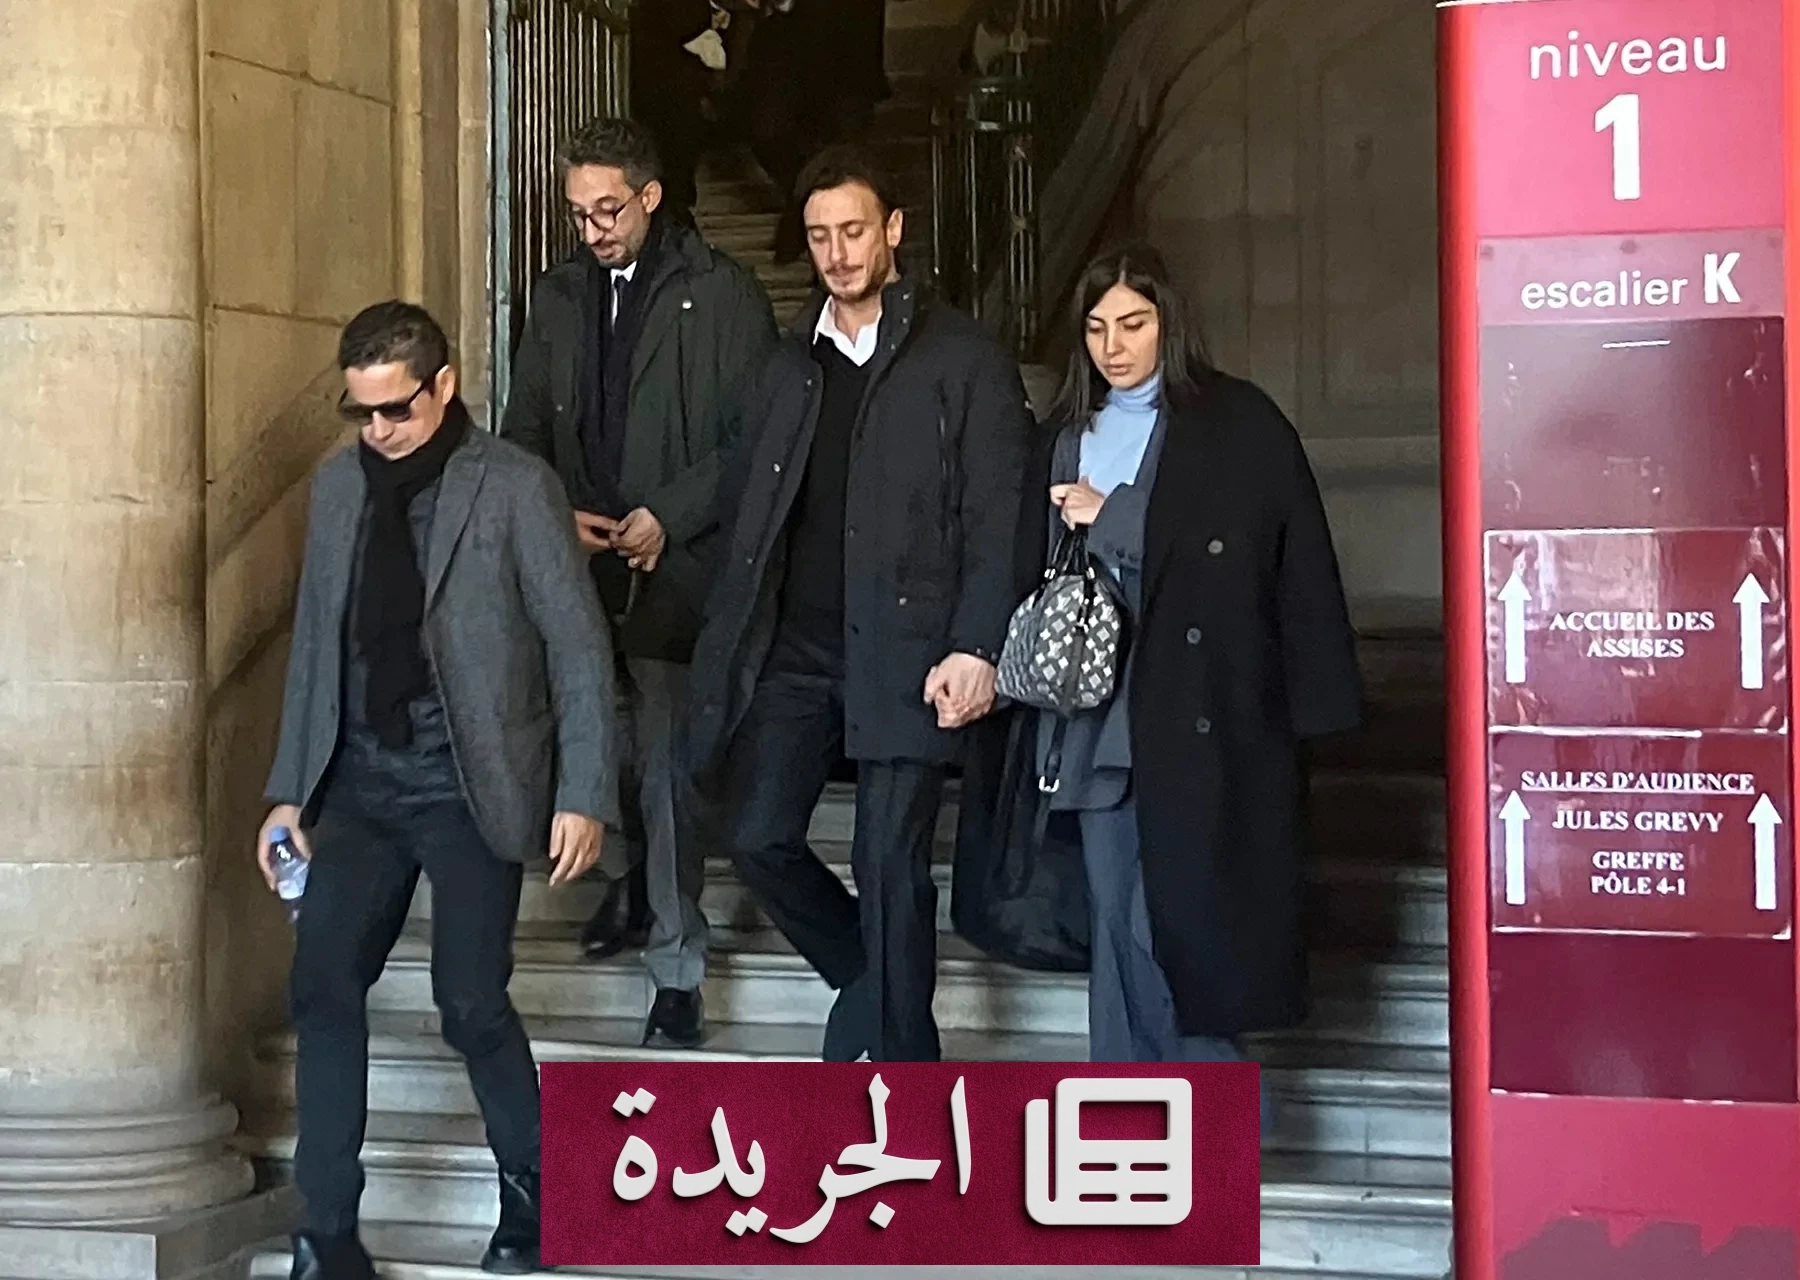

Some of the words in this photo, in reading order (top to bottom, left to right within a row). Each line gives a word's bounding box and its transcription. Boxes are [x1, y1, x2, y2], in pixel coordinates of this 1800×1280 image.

[1530, 30, 1726, 79] niveau
[1594, 94, 1640, 200] 1
[1521, 270, 1688, 309] escalier
[1703, 252, 1741, 304] K
[1549, 612, 1661, 631] ACCUEIL
[1666, 612, 1715, 631] DES
[1586, 638, 1685, 658] ASSISES
[1521, 771, 1607, 789] SALLES
[1612, 772, 1754, 791] D'AUDIENCE
[1552, 810, 1629, 831] JULES
[1634, 812, 1724, 832] GREVY
[1592, 851, 1684, 871] GREFFE
[1591, 871, 1651, 894] PÔLE
[1656, 877, 1686, 895] 4-1
